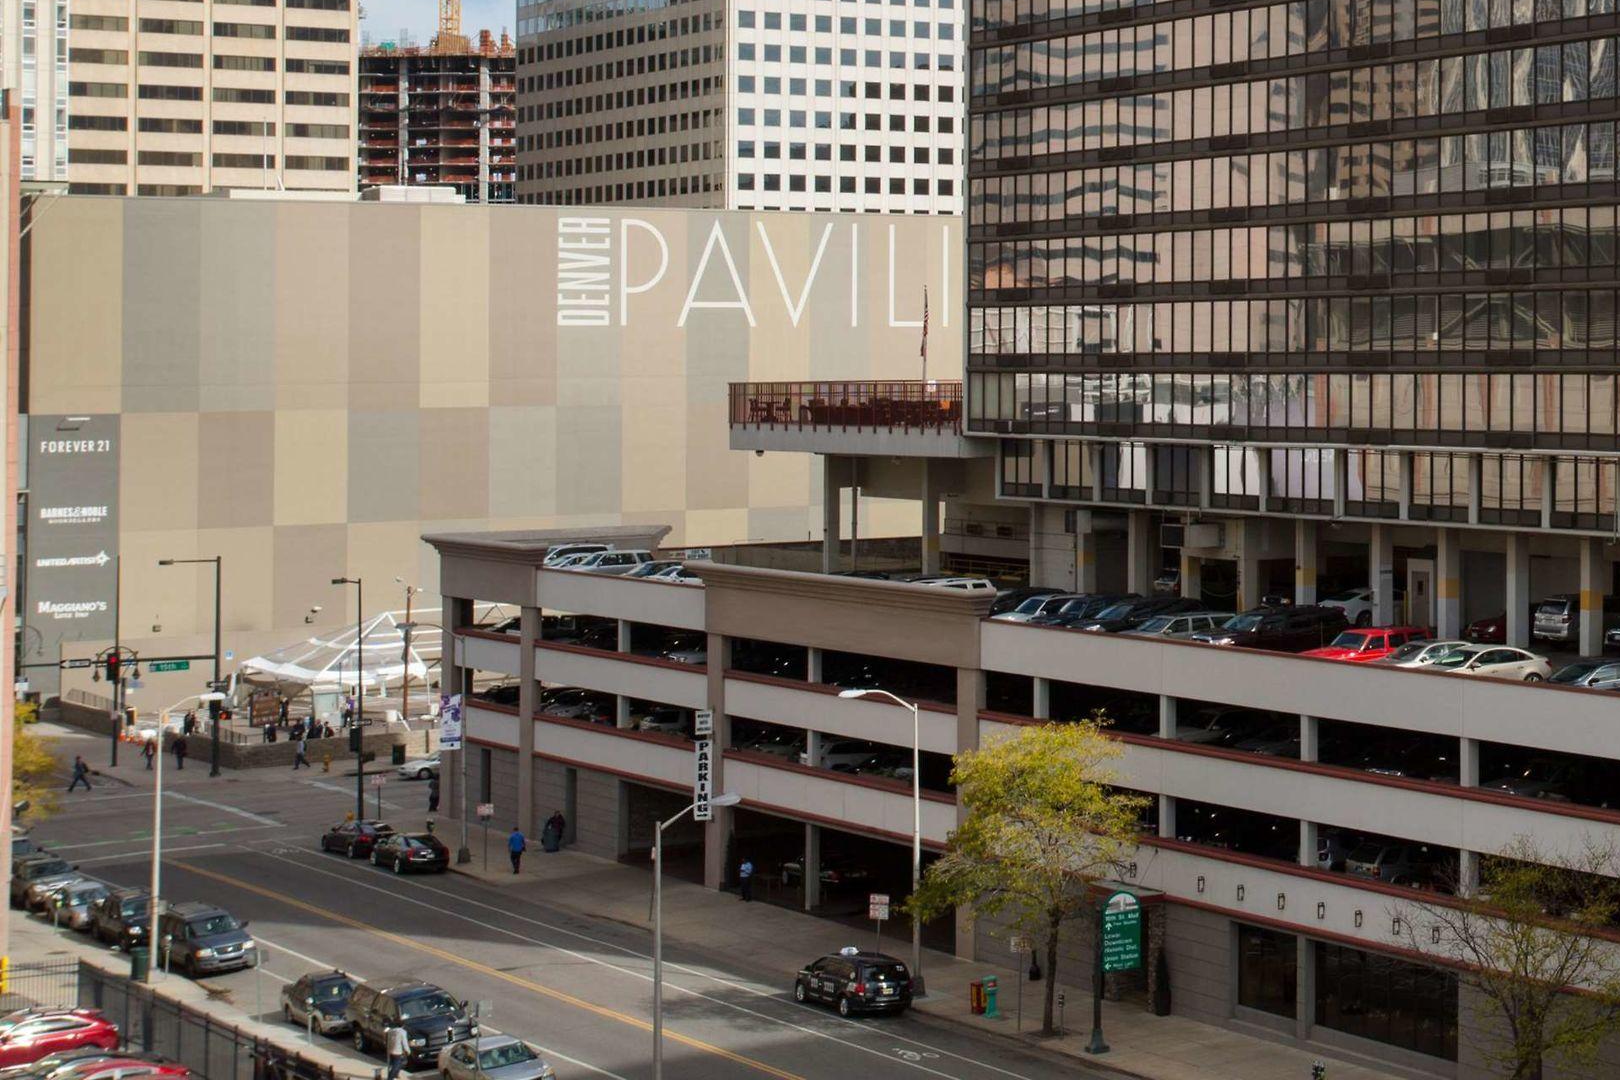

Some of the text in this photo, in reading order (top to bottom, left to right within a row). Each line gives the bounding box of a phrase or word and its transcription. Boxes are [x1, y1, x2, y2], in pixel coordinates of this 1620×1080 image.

[557, 217, 611, 326] DENVER
[40, 440, 110, 453] FOREVER 21
[40, 508, 73, 519] BARNES
[81, 506, 108, 517] NOBLE
[698, 742, 709, 813] PARKING
